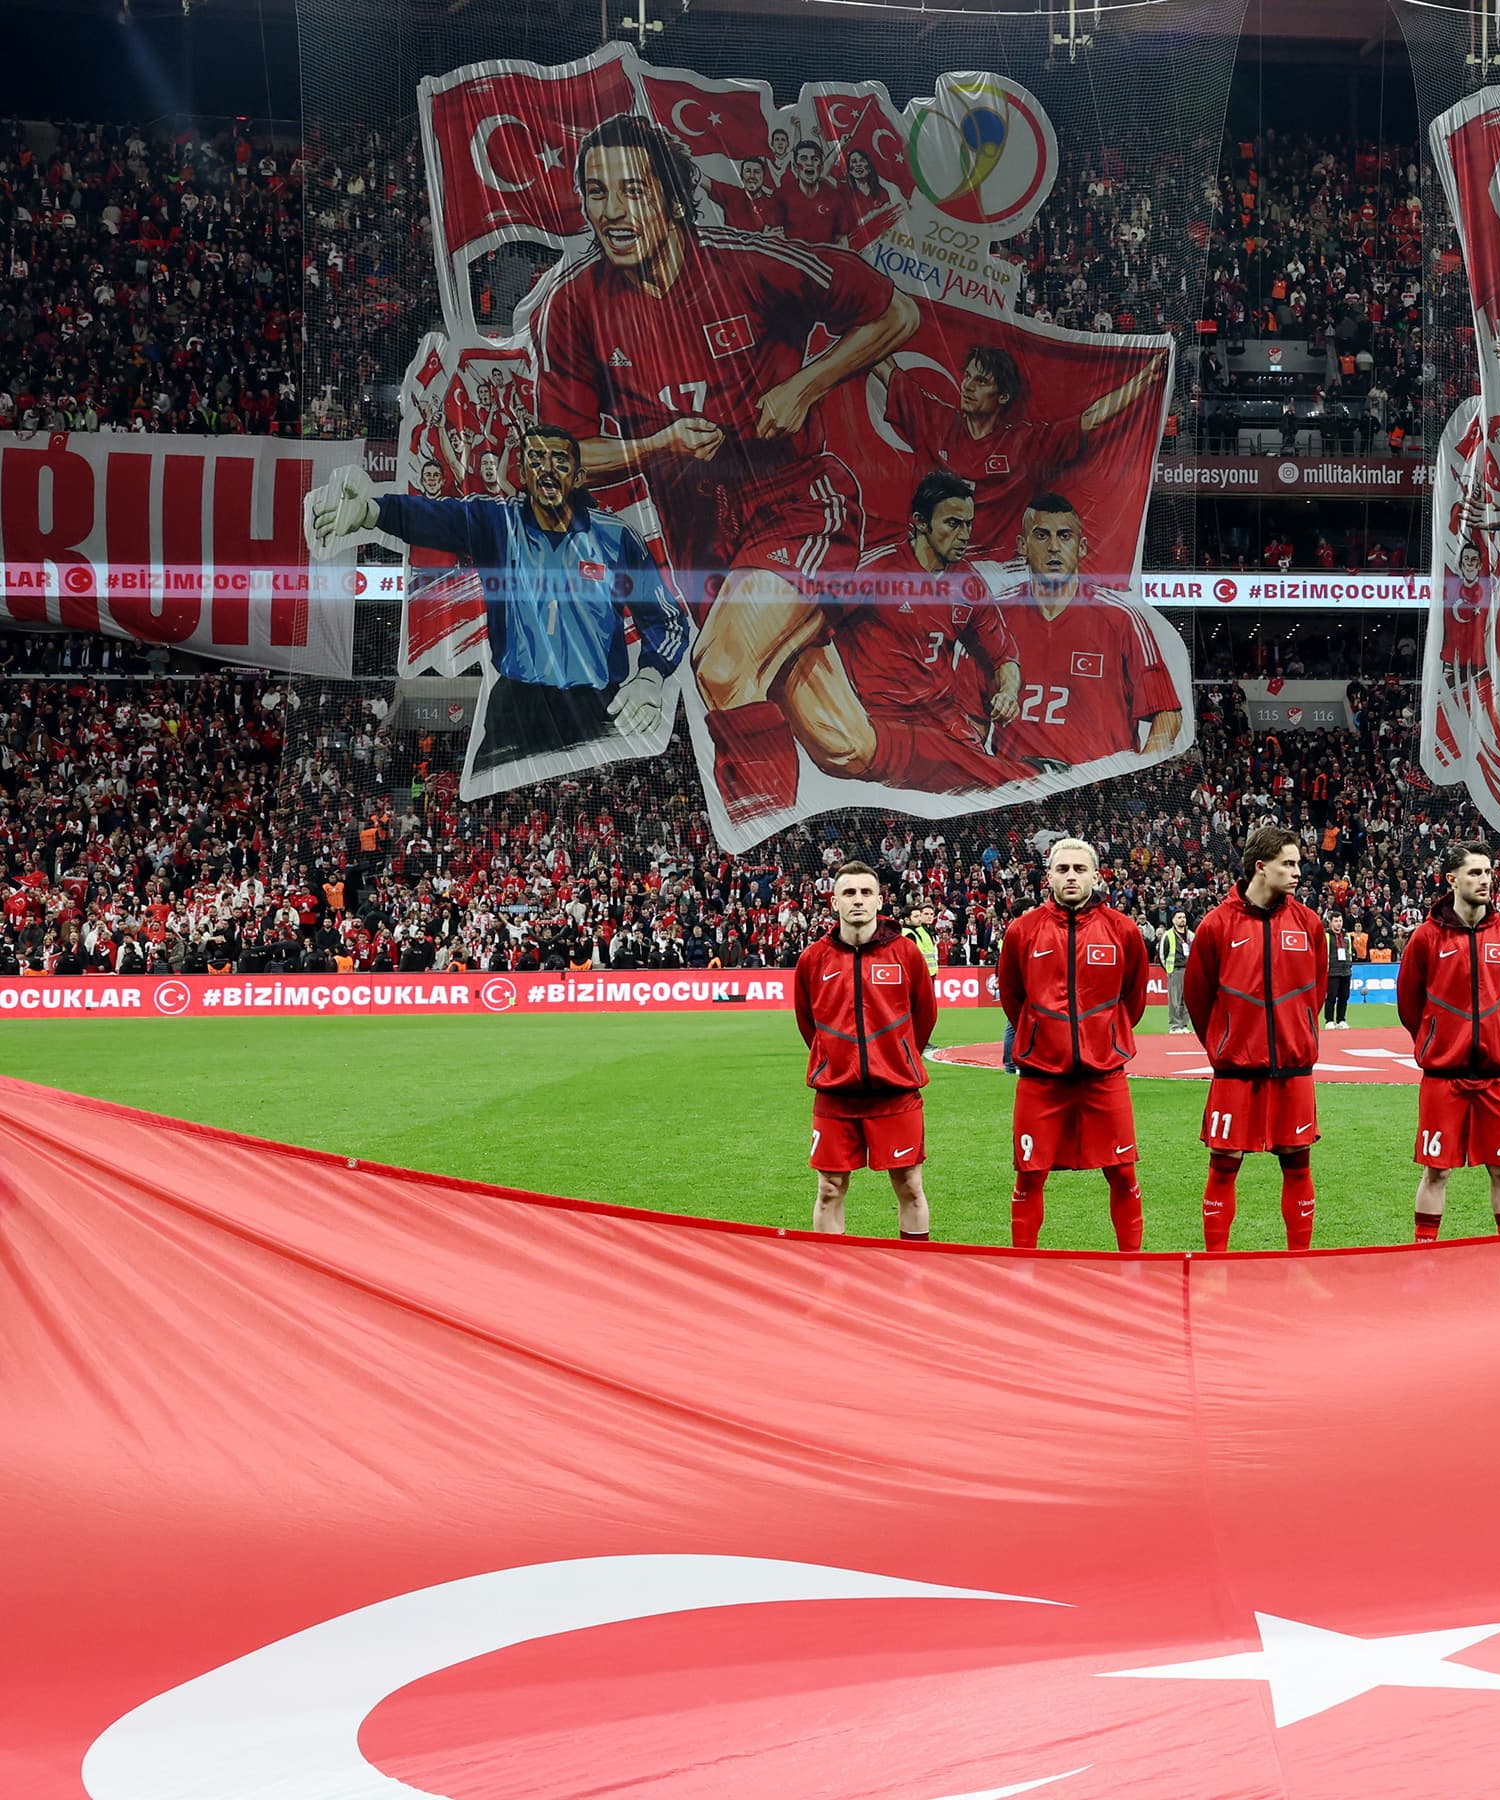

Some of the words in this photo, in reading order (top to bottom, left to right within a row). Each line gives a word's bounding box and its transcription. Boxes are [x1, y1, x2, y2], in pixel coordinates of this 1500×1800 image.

[926, 220, 980, 255] 2002
[880, 229, 915, 250] FIFA
[921, 241, 979, 272] WORLD
[983, 265, 1011, 286] CUP
[874, 243, 942, 288] KOREA
[937, 268, 1006, 310] JAPAN
[658, 379, 707, 413] 17
[1154, 462, 1259, 489] Federasyonu
[1303, 463, 1404, 485] millitakimlar
[2, 447, 314, 648] RUH
[1249, 580, 1446, 603] #BİZİMÇOCUKLA
[415, 707, 439, 720] 114
[1021, 684, 1070, 725] 22
[1258, 709, 1279, 721] 115
[1313, 710, 1334, 722] 116
[202, 982, 469, 1010] #BİZİMÇOCUKLAR
[1210, 1110, 1233, 1140] 11
[1020, 1133, 1034, 1162] 9
[1422, 1129, 1443, 1157] 16
